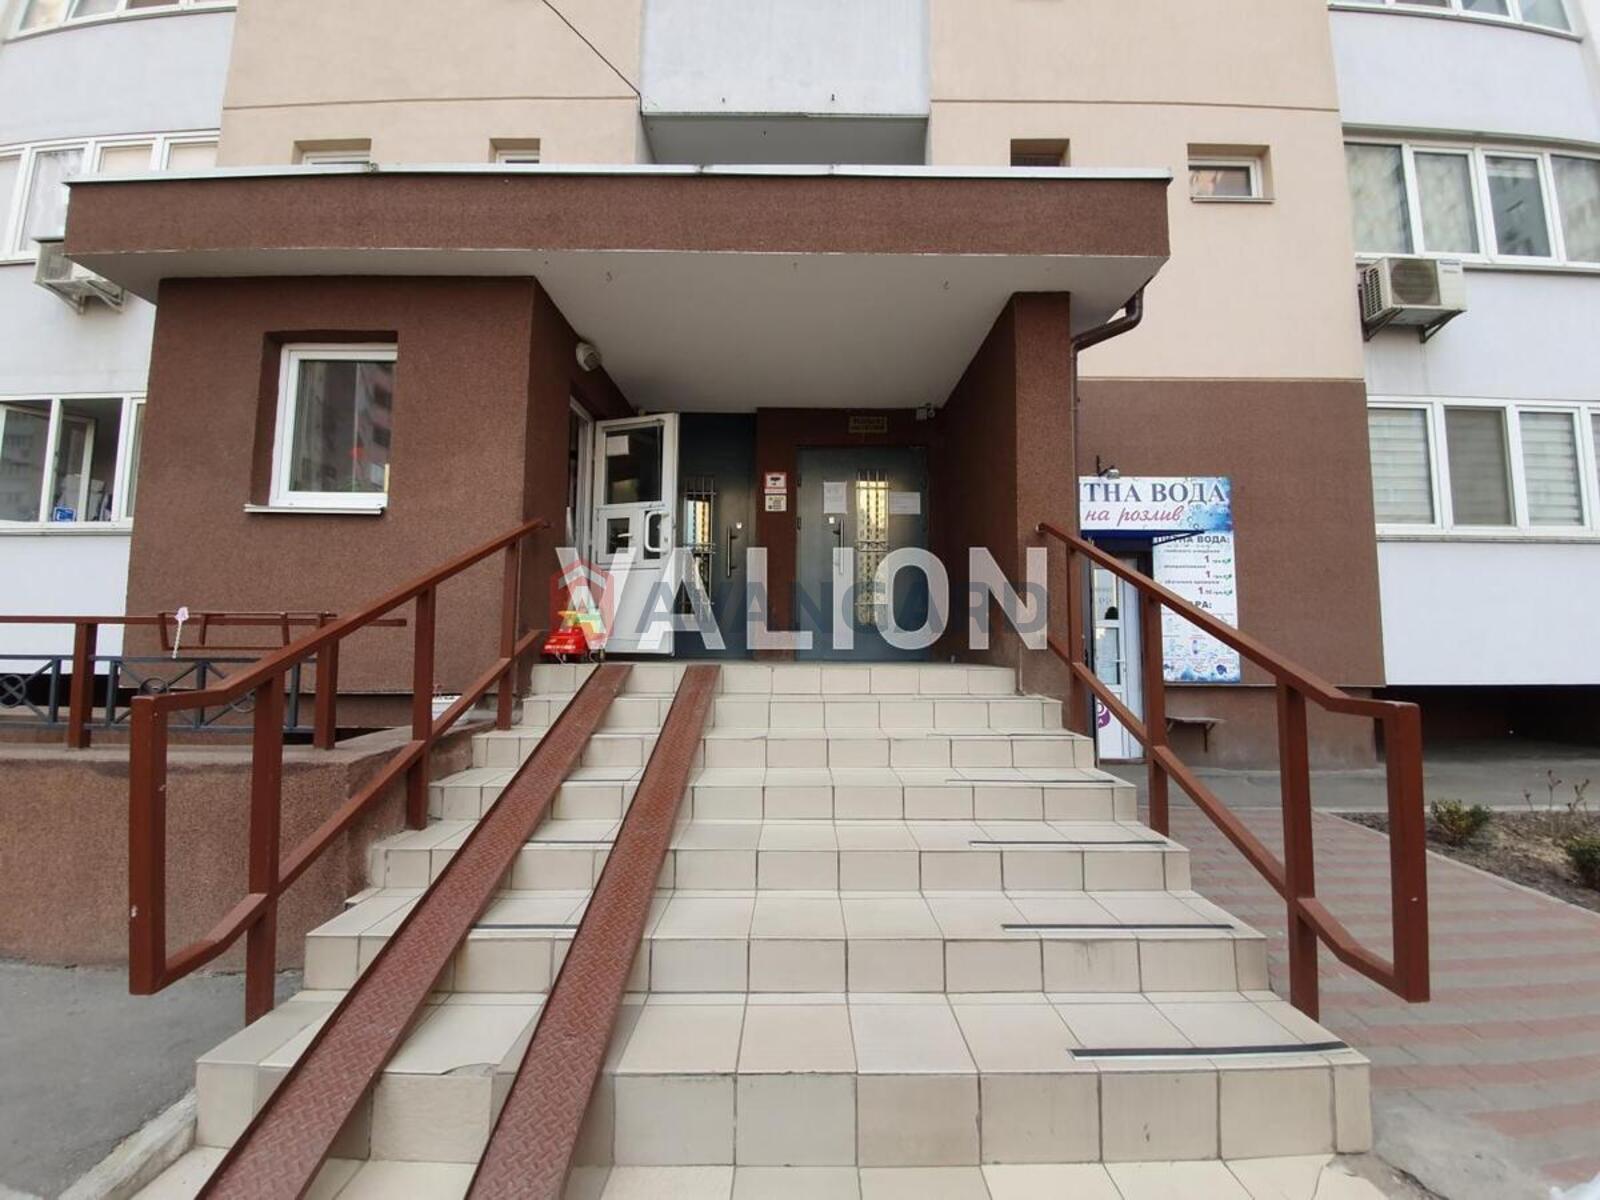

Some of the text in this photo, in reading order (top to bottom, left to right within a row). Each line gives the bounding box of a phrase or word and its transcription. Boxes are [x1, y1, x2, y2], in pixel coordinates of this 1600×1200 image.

[1151, 482, 1226, 505] ВОДА
[1084, 505, 1185, 526] на розлив
[1197, 535, 1231, 545] ВОДА:
